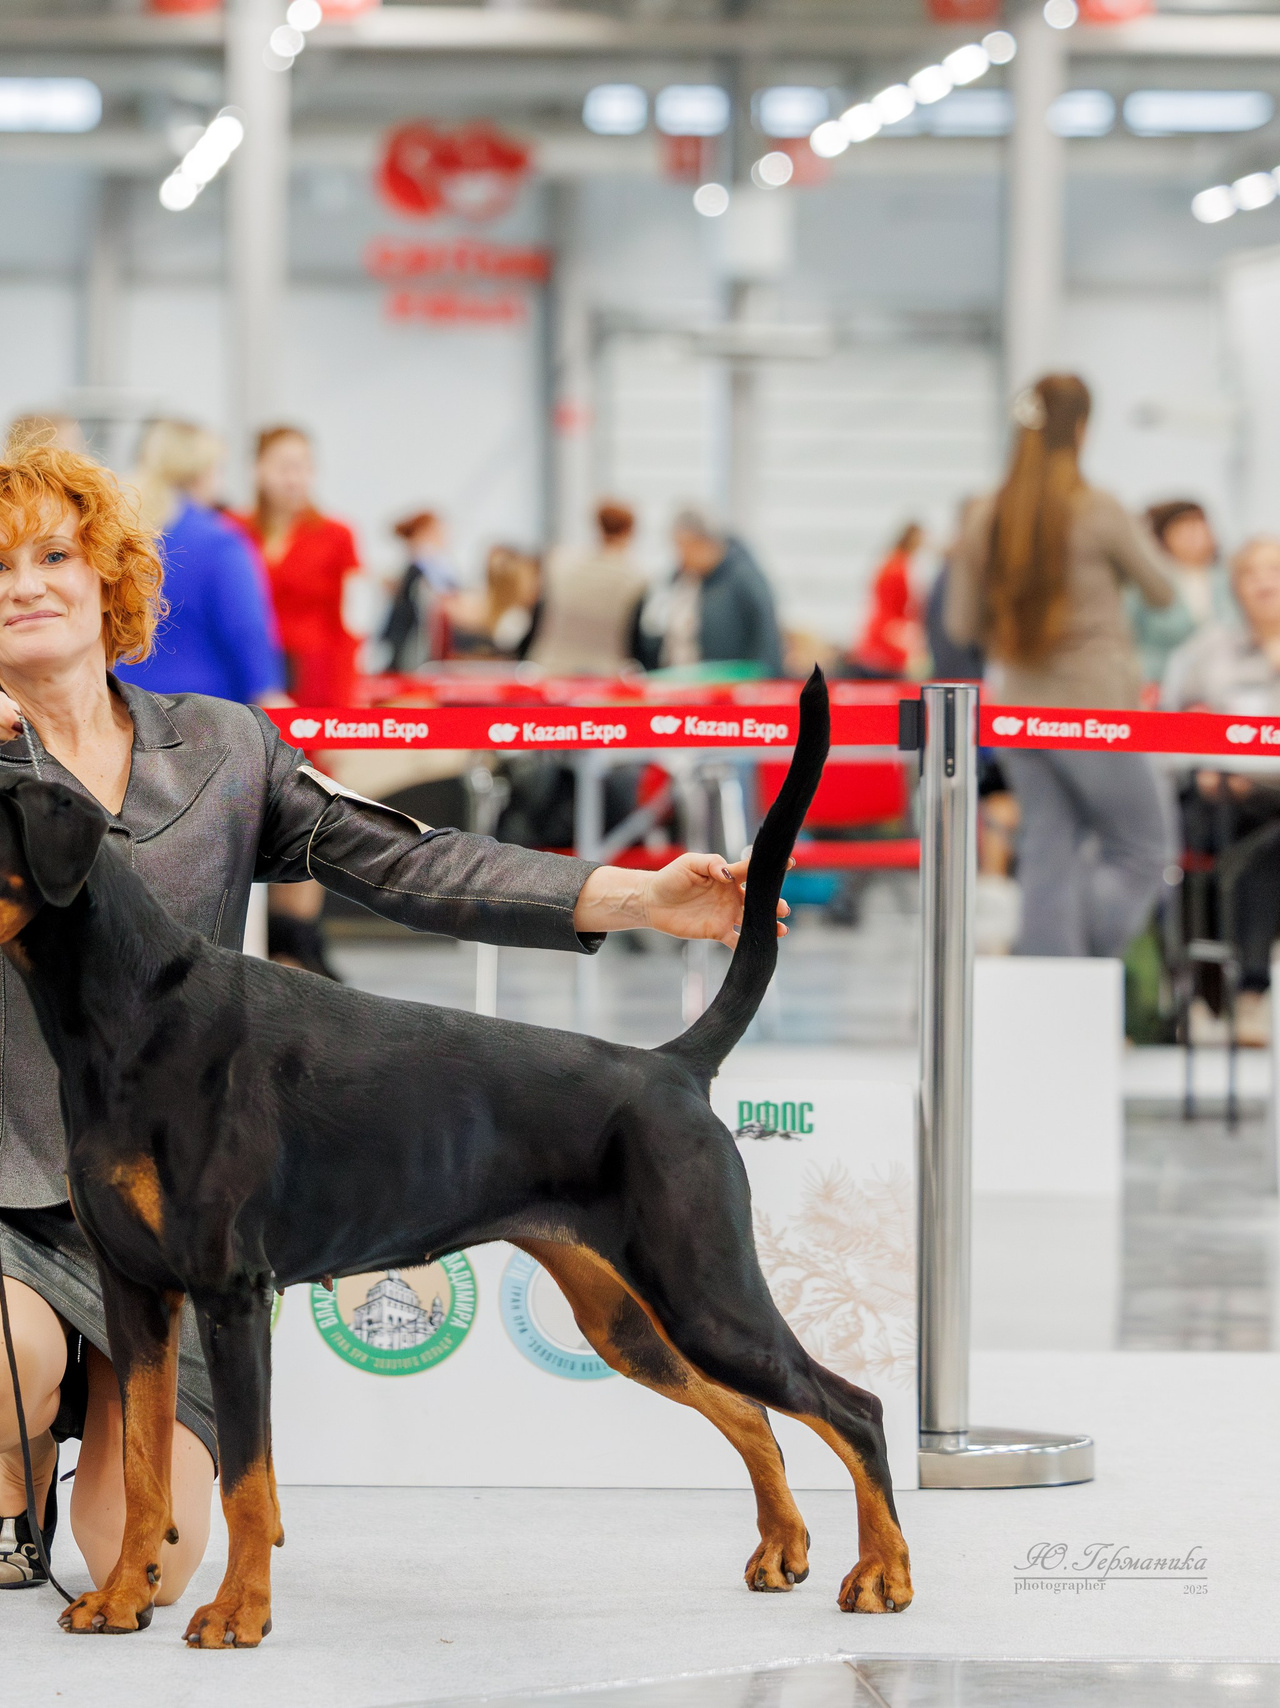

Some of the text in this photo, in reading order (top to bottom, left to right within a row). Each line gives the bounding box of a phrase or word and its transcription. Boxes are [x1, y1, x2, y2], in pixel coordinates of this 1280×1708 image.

[324, 718, 429, 743] Kazan Expo
[522, 720, 627, 745] Kazan Expo
[684, 716, 788, 743] Kazan Expo
[1026, 717, 1131, 744] Kazan Expo
[738, 1099, 815, 1134] РФОС
[442, 1252, 476, 1329] ЛАДИМИРА
[312, 1282, 339, 1329] ВЛАД
